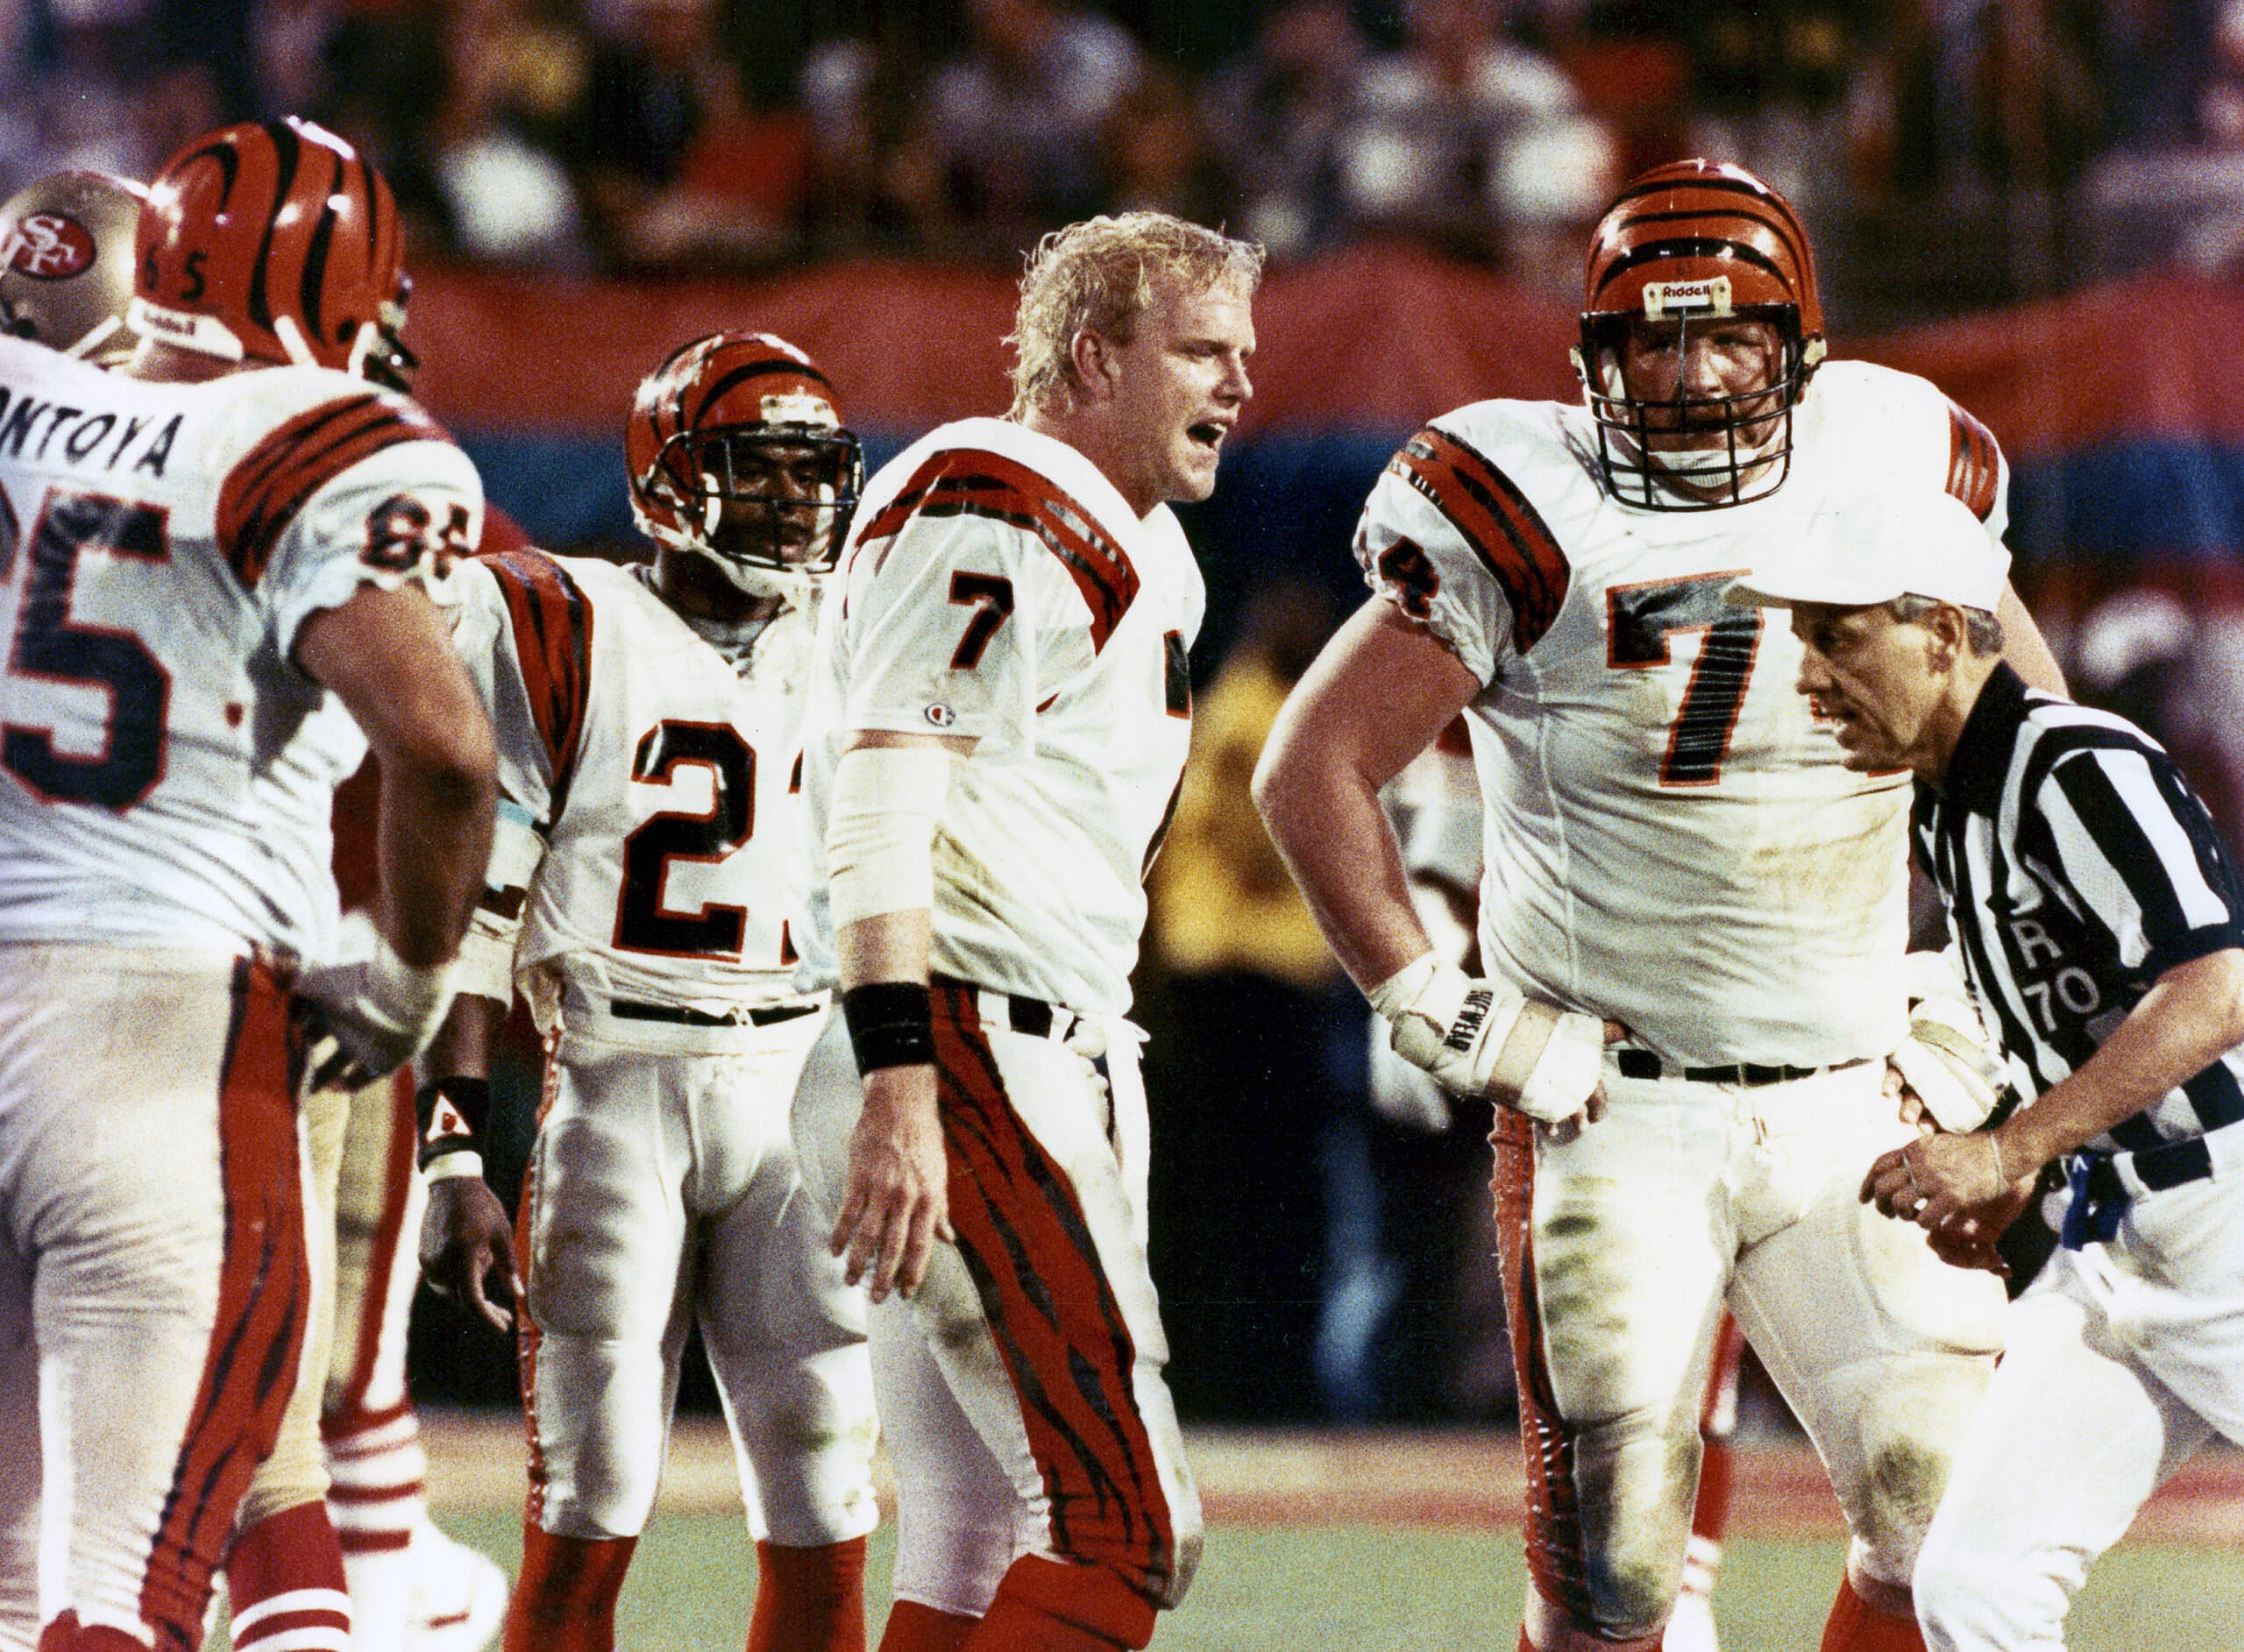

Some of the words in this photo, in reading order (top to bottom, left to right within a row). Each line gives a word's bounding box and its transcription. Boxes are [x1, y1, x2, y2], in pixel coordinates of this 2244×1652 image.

[1663, 285, 1712, 298] Riddell
[0, 482, 172, 815] 5
[948, 570, 1015, 670] 7
[614, 719, 799, 966] 2
[2011, 919, 2062, 969] R
[2022, 967, 2099, 1032] 70
